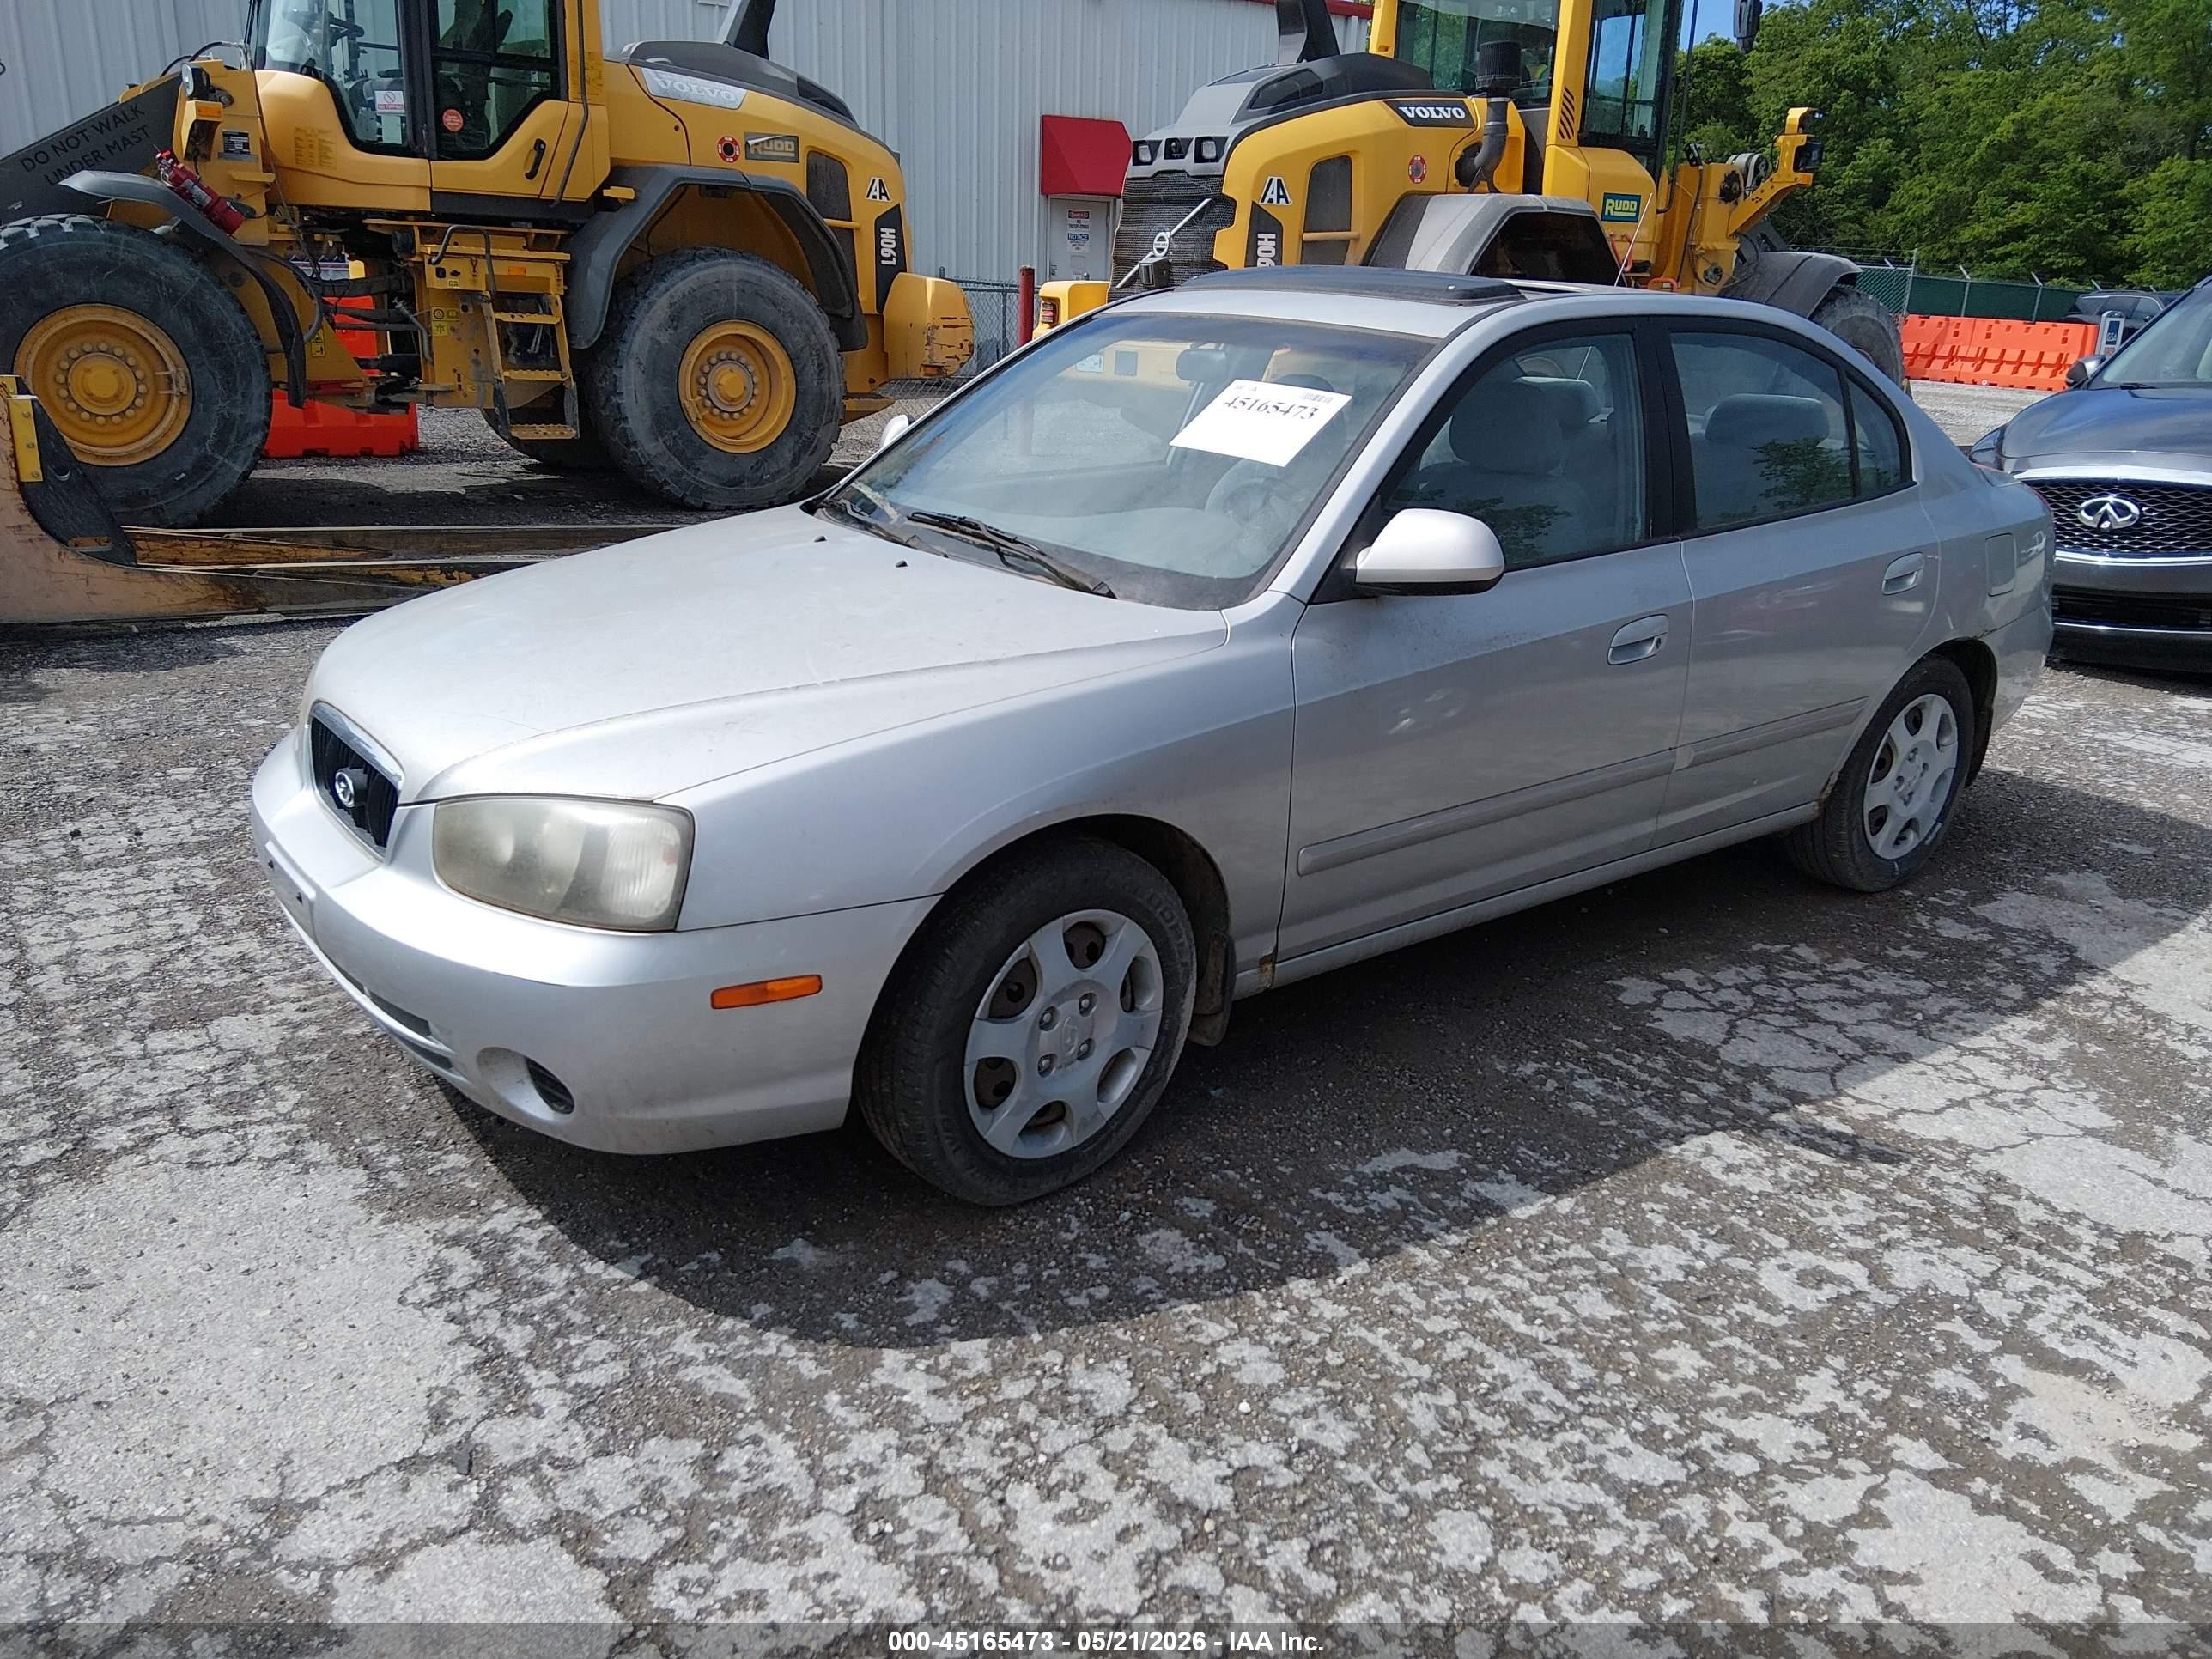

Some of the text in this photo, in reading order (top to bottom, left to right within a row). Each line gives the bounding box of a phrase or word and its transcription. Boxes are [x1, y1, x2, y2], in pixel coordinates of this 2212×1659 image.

[655, 76, 737, 102] VOLVO
[1398, 106, 1466, 119] VOLVO
[21, 103, 145, 173] DO NOT WALK
[750, 138, 796, 155] RUDD
[44, 125, 151, 185] UNDER MAST
[1605, 198, 1638, 216] RUDD
[880, 228, 896, 266] L90H
[1257, 234, 1276, 268] 90H
[1224, 396, 1318, 420] 45165473
